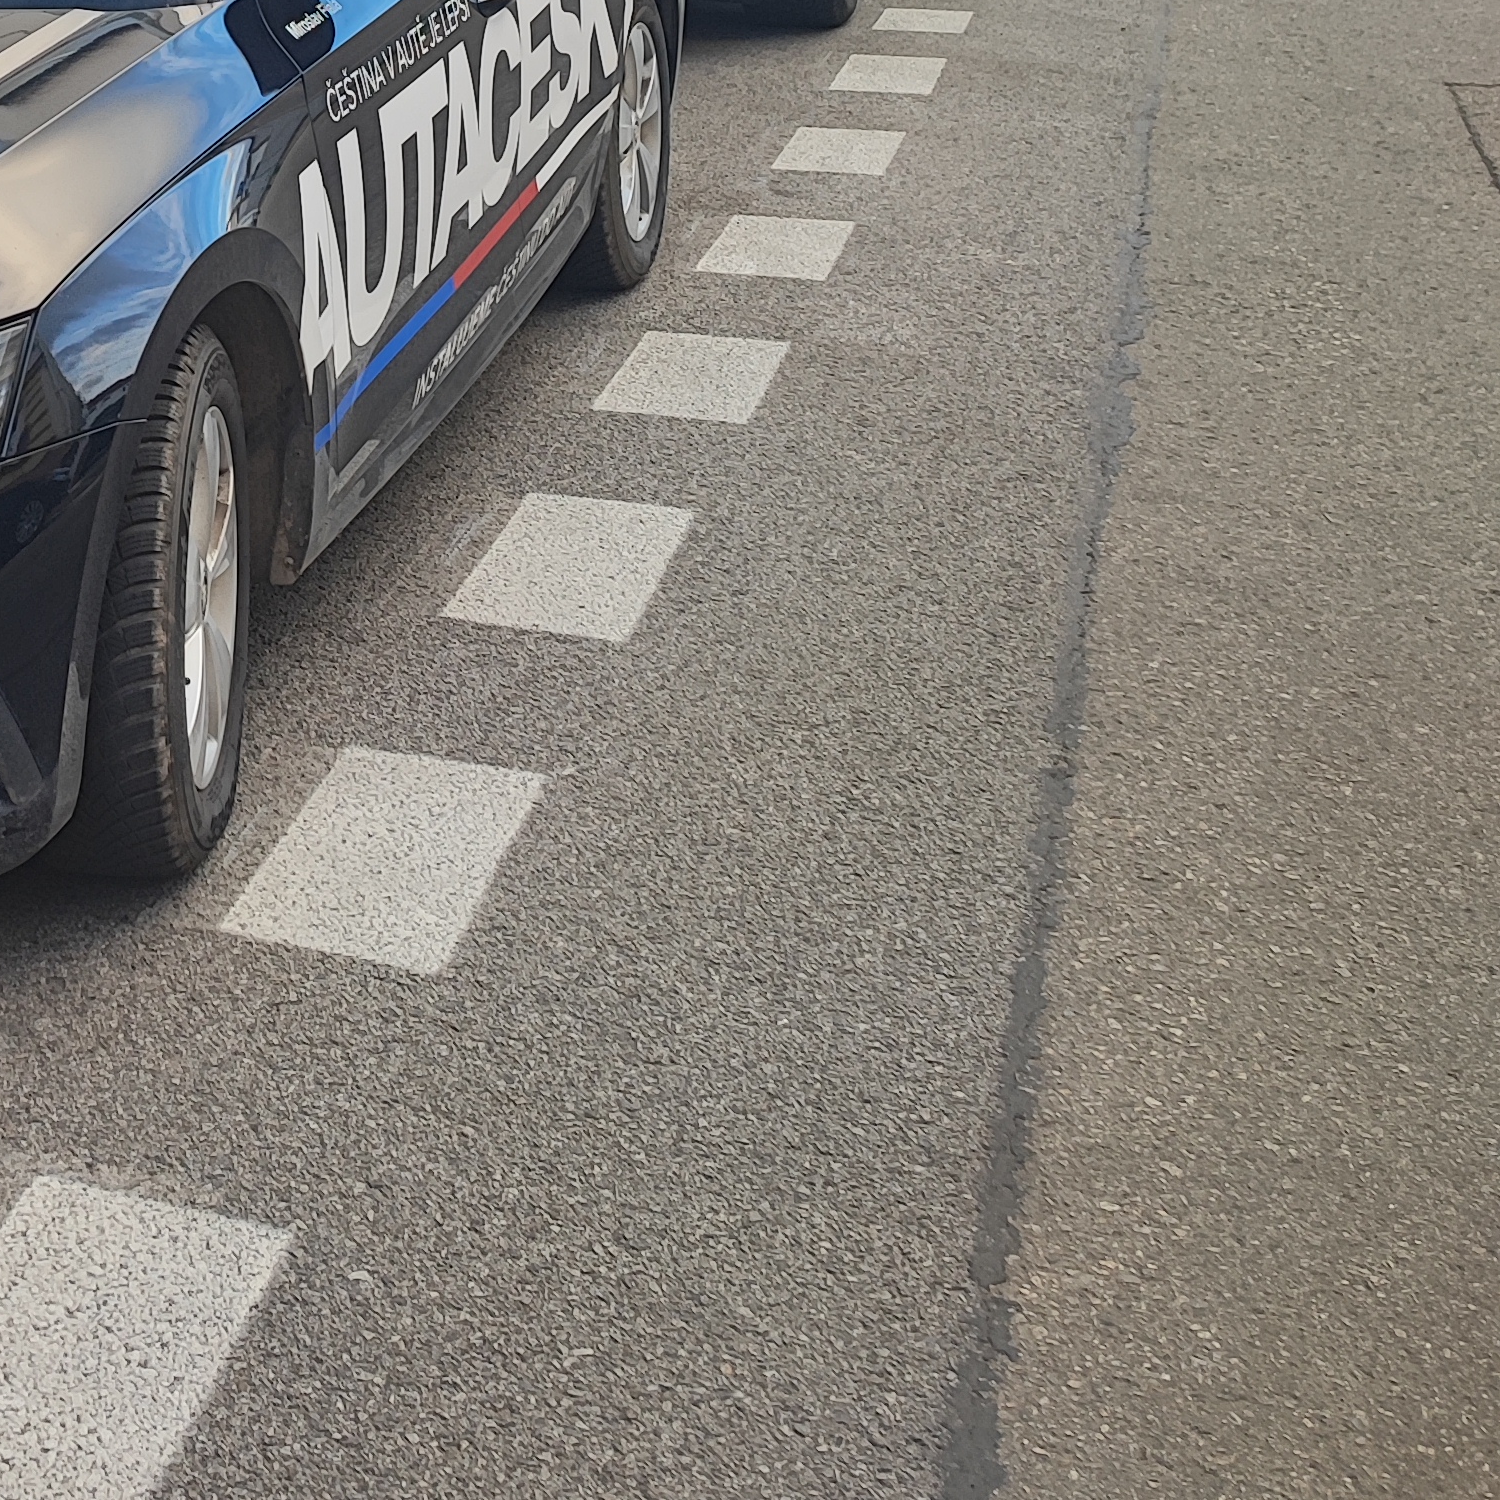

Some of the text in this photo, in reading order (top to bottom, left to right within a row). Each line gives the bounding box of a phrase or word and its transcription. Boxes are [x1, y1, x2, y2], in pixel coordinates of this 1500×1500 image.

[326, 57, 388, 122] ČEŠTINA
[381, 46, 395, 80] V
[428, 11, 444, 48] JE
